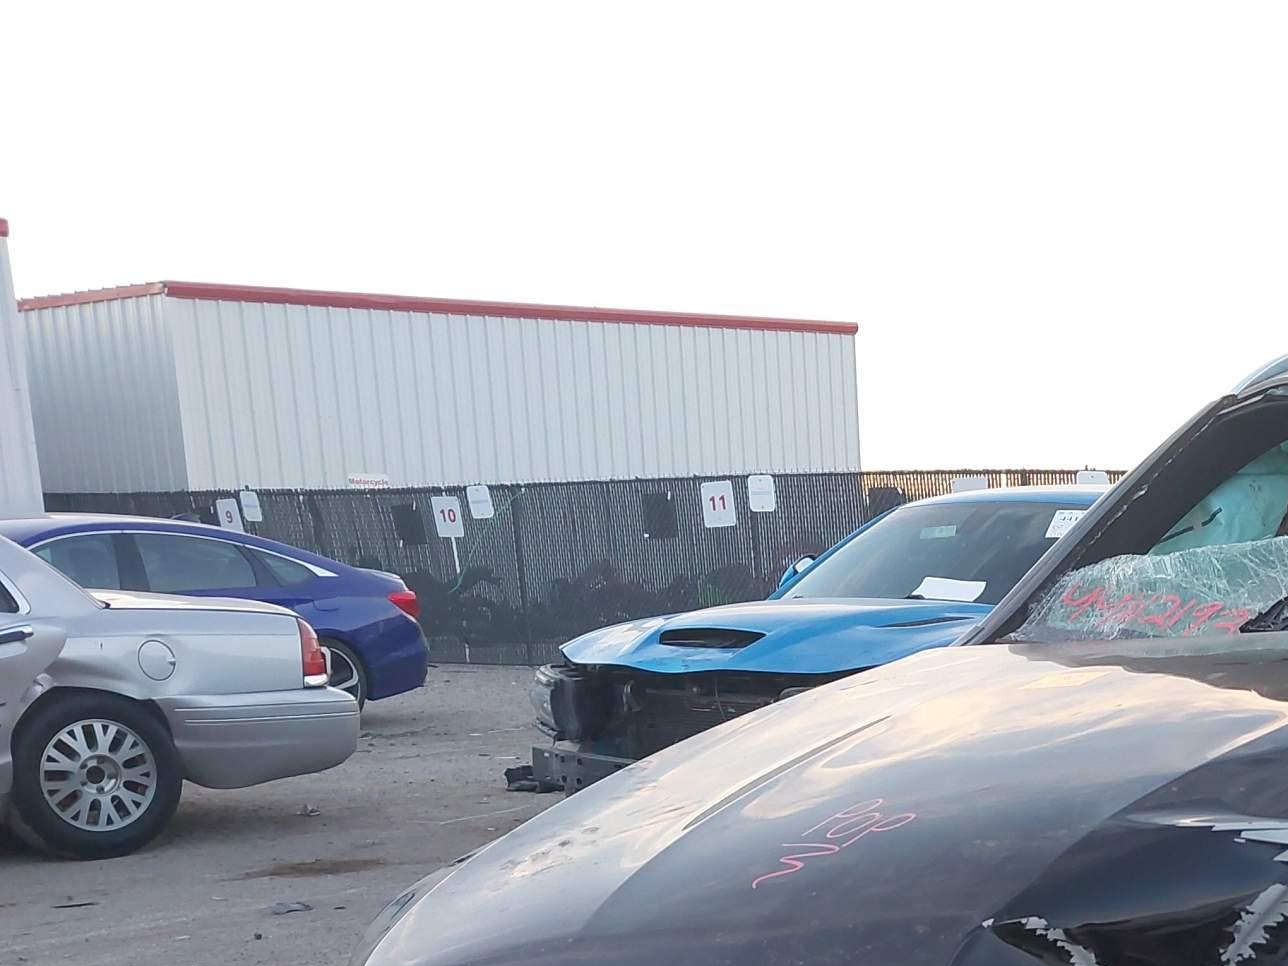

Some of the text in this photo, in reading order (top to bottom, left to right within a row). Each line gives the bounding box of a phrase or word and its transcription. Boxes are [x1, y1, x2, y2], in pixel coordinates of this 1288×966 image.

[709, 495, 727, 511] 11
[225, 510, 233, 524] 9
[440, 508, 456, 523] 10
